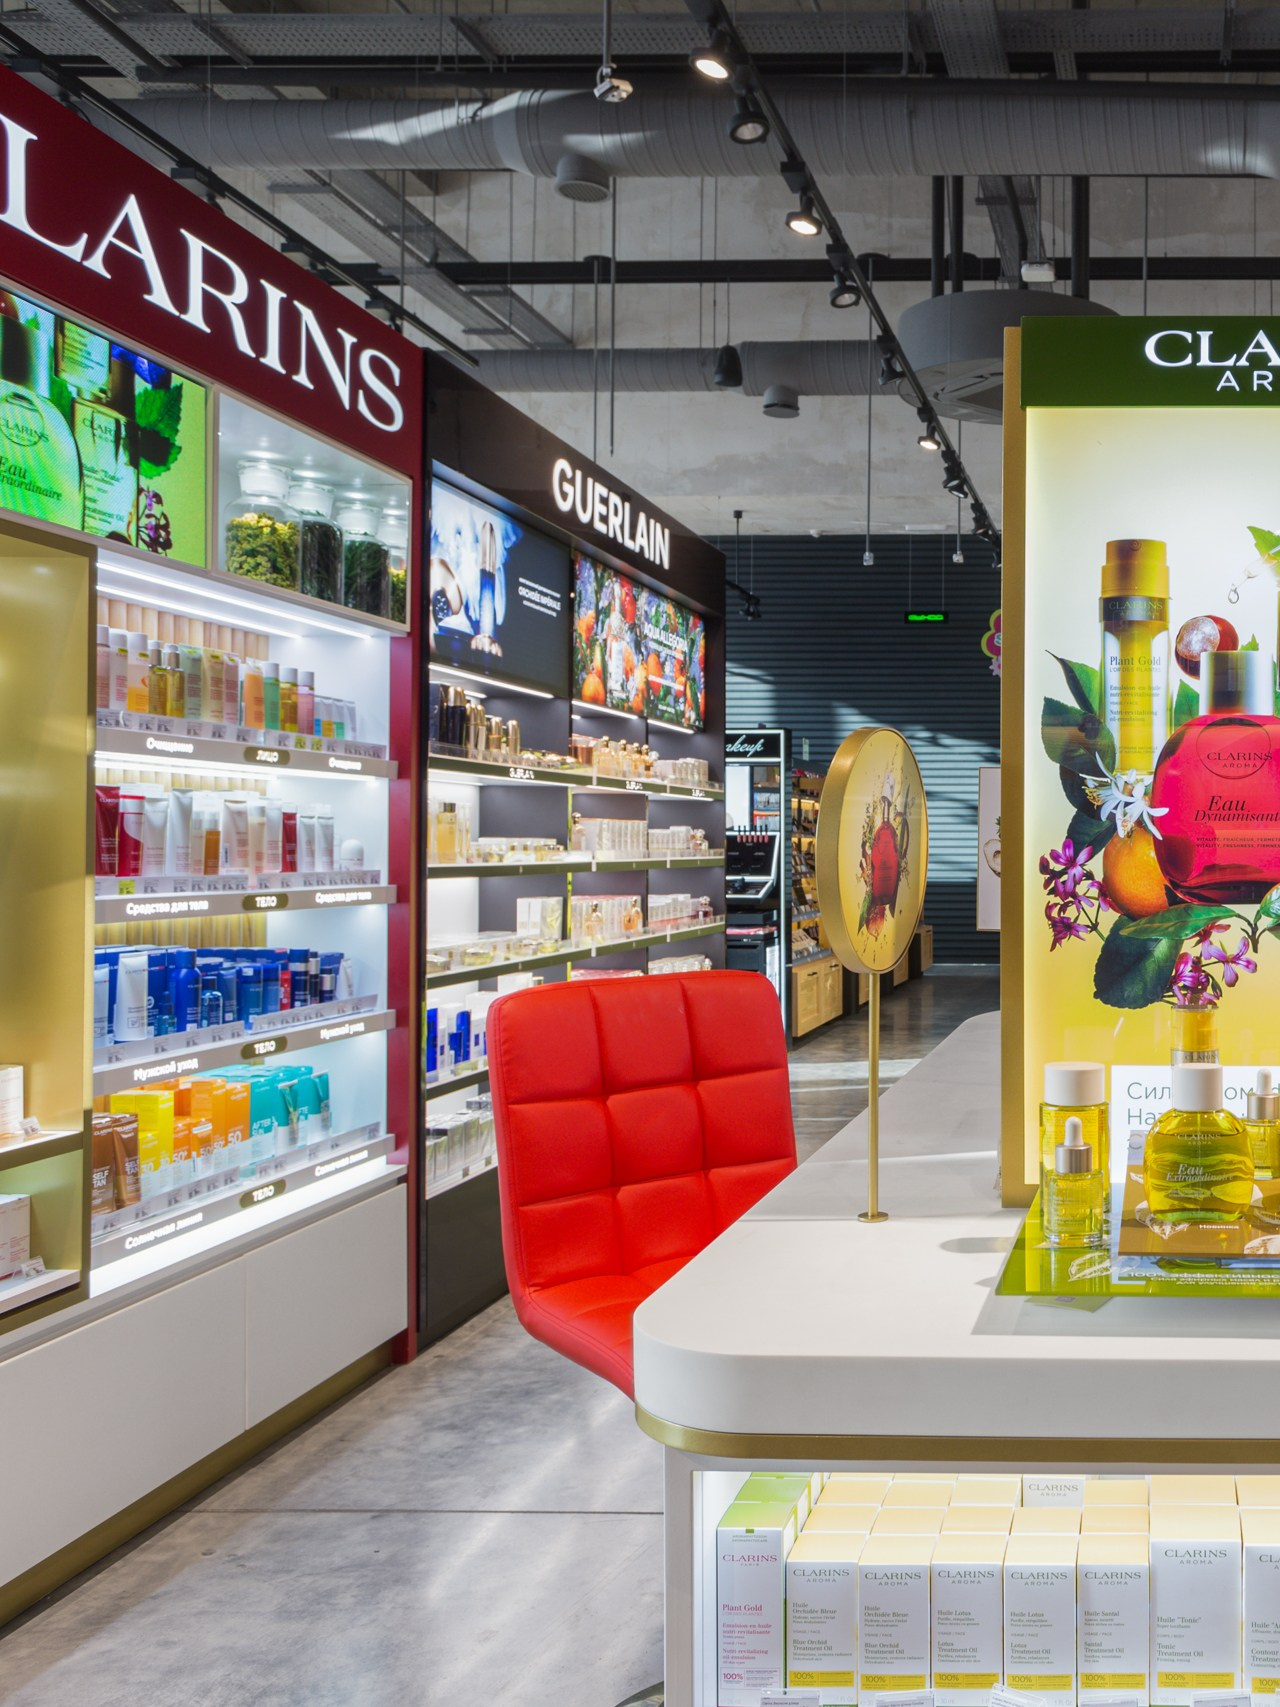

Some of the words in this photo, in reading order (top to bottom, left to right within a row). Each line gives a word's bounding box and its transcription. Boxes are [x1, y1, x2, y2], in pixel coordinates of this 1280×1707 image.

[552, 458, 670, 570] GUERLAIN
[1110, 656, 1134, 666] Plant
[1138, 656, 1161, 666] Gold
[256, 750, 279, 763] ЛИЦО
[1207, 752, 1273, 760] CLARINS
[1208, 795, 1246, 812] Eau
[255, 896, 277, 908] ТЕЛО
[254, 1041, 276, 1055] ТЕЛО
[227, 1132, 242, 1145] 50
[1177, 1133, 1221, 1141] CLARINS
[1177, 1164, 1204, 1175] Eau
[92, 1169, 110, 1182] SELF
[1166, 1173, 1234, 1181] Extraordinaire
[93, 1178, 107, 1188] TAN
[252, 1186, 275, 1202] ТЕЛО
[1029, 1484, 1078, 1492] CLARINS
[723, 1554, 778, 1562] CLARINS
[1164, 1550, 1227, 1558] CLARINS
[793, 1569, 850, 1577] CLARINS
[864, 1572, 922, 1580] CLARINS
[938, 1570, 995, 1578] CLARINS
[1010, 1572, 1068, 1580] CLARINS
[1084, 1572, 1142, 1580] CLARINS
[722, 1604, 742, 1612] Plant
[744, 1604, 763, 1612] Gold
